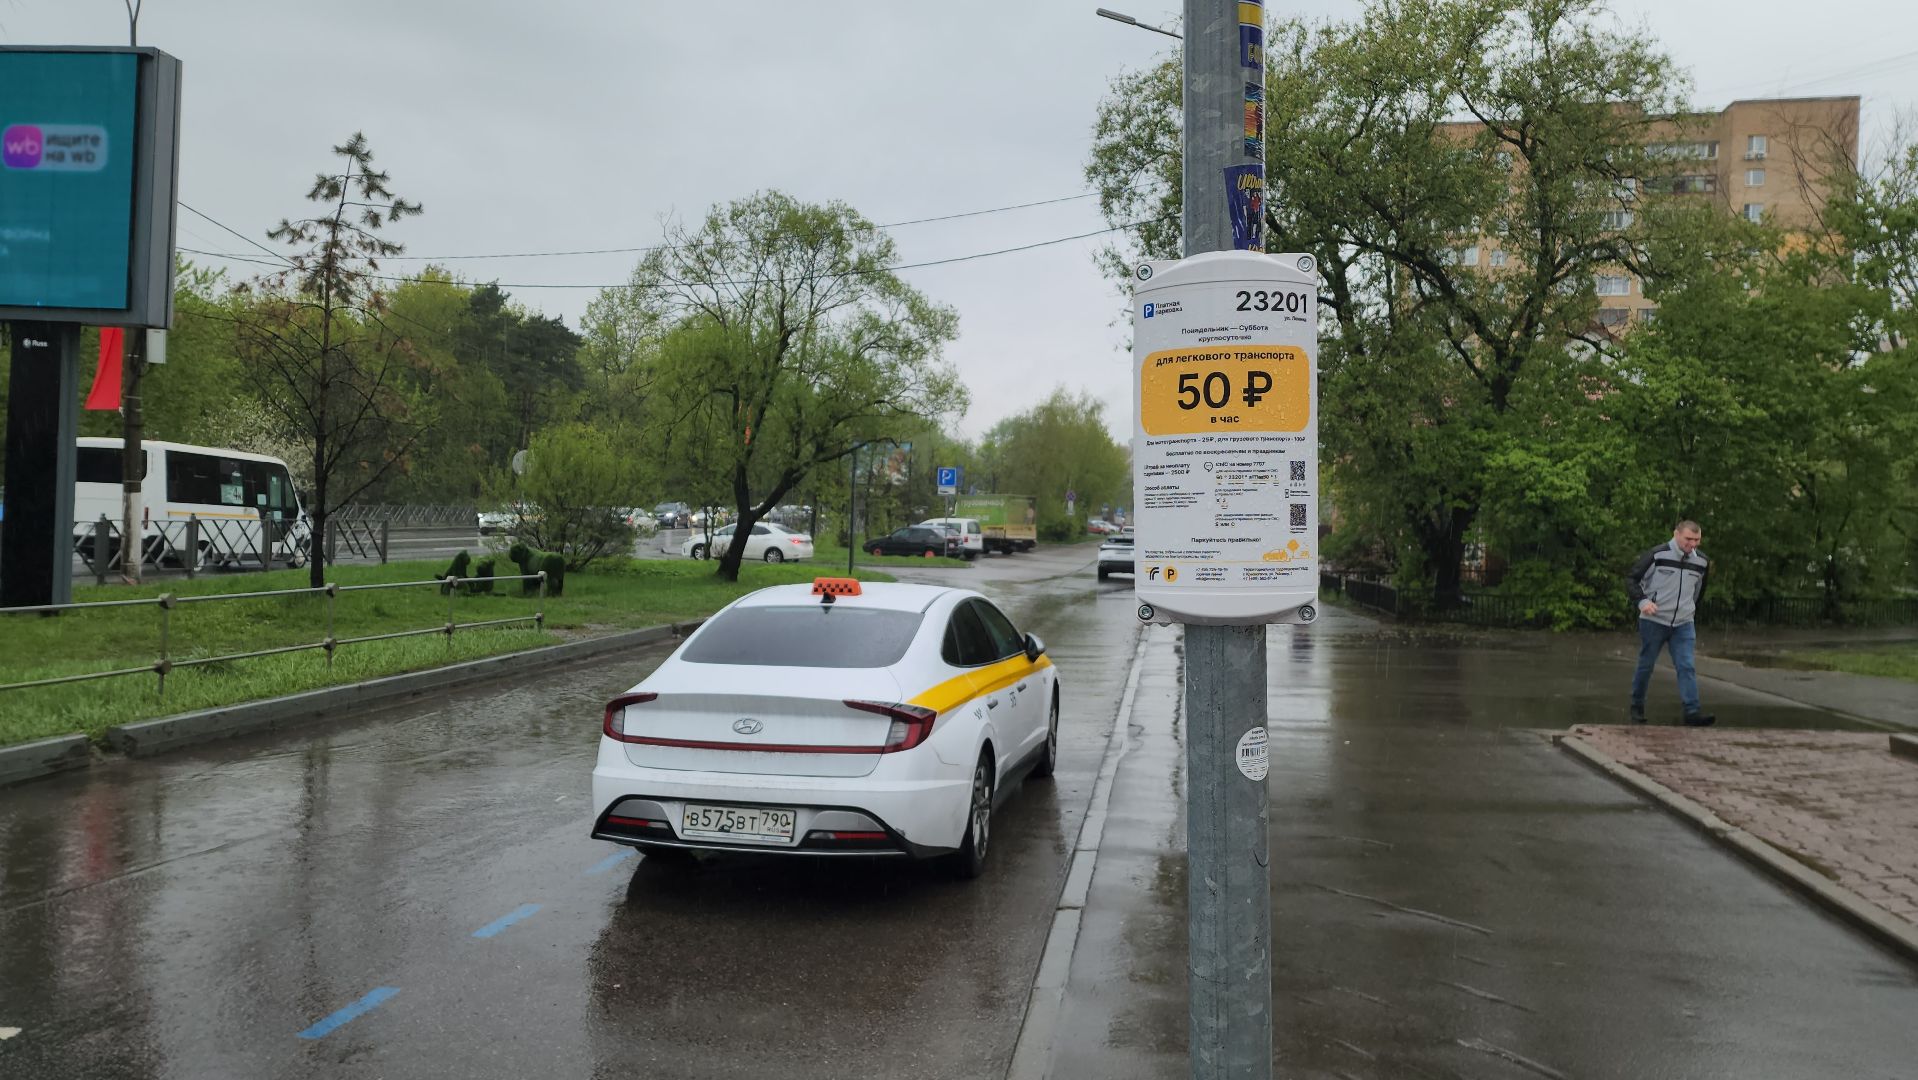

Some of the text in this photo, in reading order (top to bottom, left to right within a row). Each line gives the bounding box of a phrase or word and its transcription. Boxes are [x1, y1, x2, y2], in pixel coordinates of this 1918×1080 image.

[6, 135, 39, 156] wb
[46, 134, 100, 149] ищите
[46, 149, 96, 164] на wb
[1155, 301, 1180, 309] Платная
[1236, 290, 1307, 314] 23201
[1181, 326, 1229, 335] Понедельник
[1239, 324, 1269, 333] Суббота
[1198, 335, 1252, 343] круглосуточно
[1156, 352, 1295, 367] для легкового транспорта
[1177, 371, 1230, 410] 50
[761, 811, 790, 828] 790
